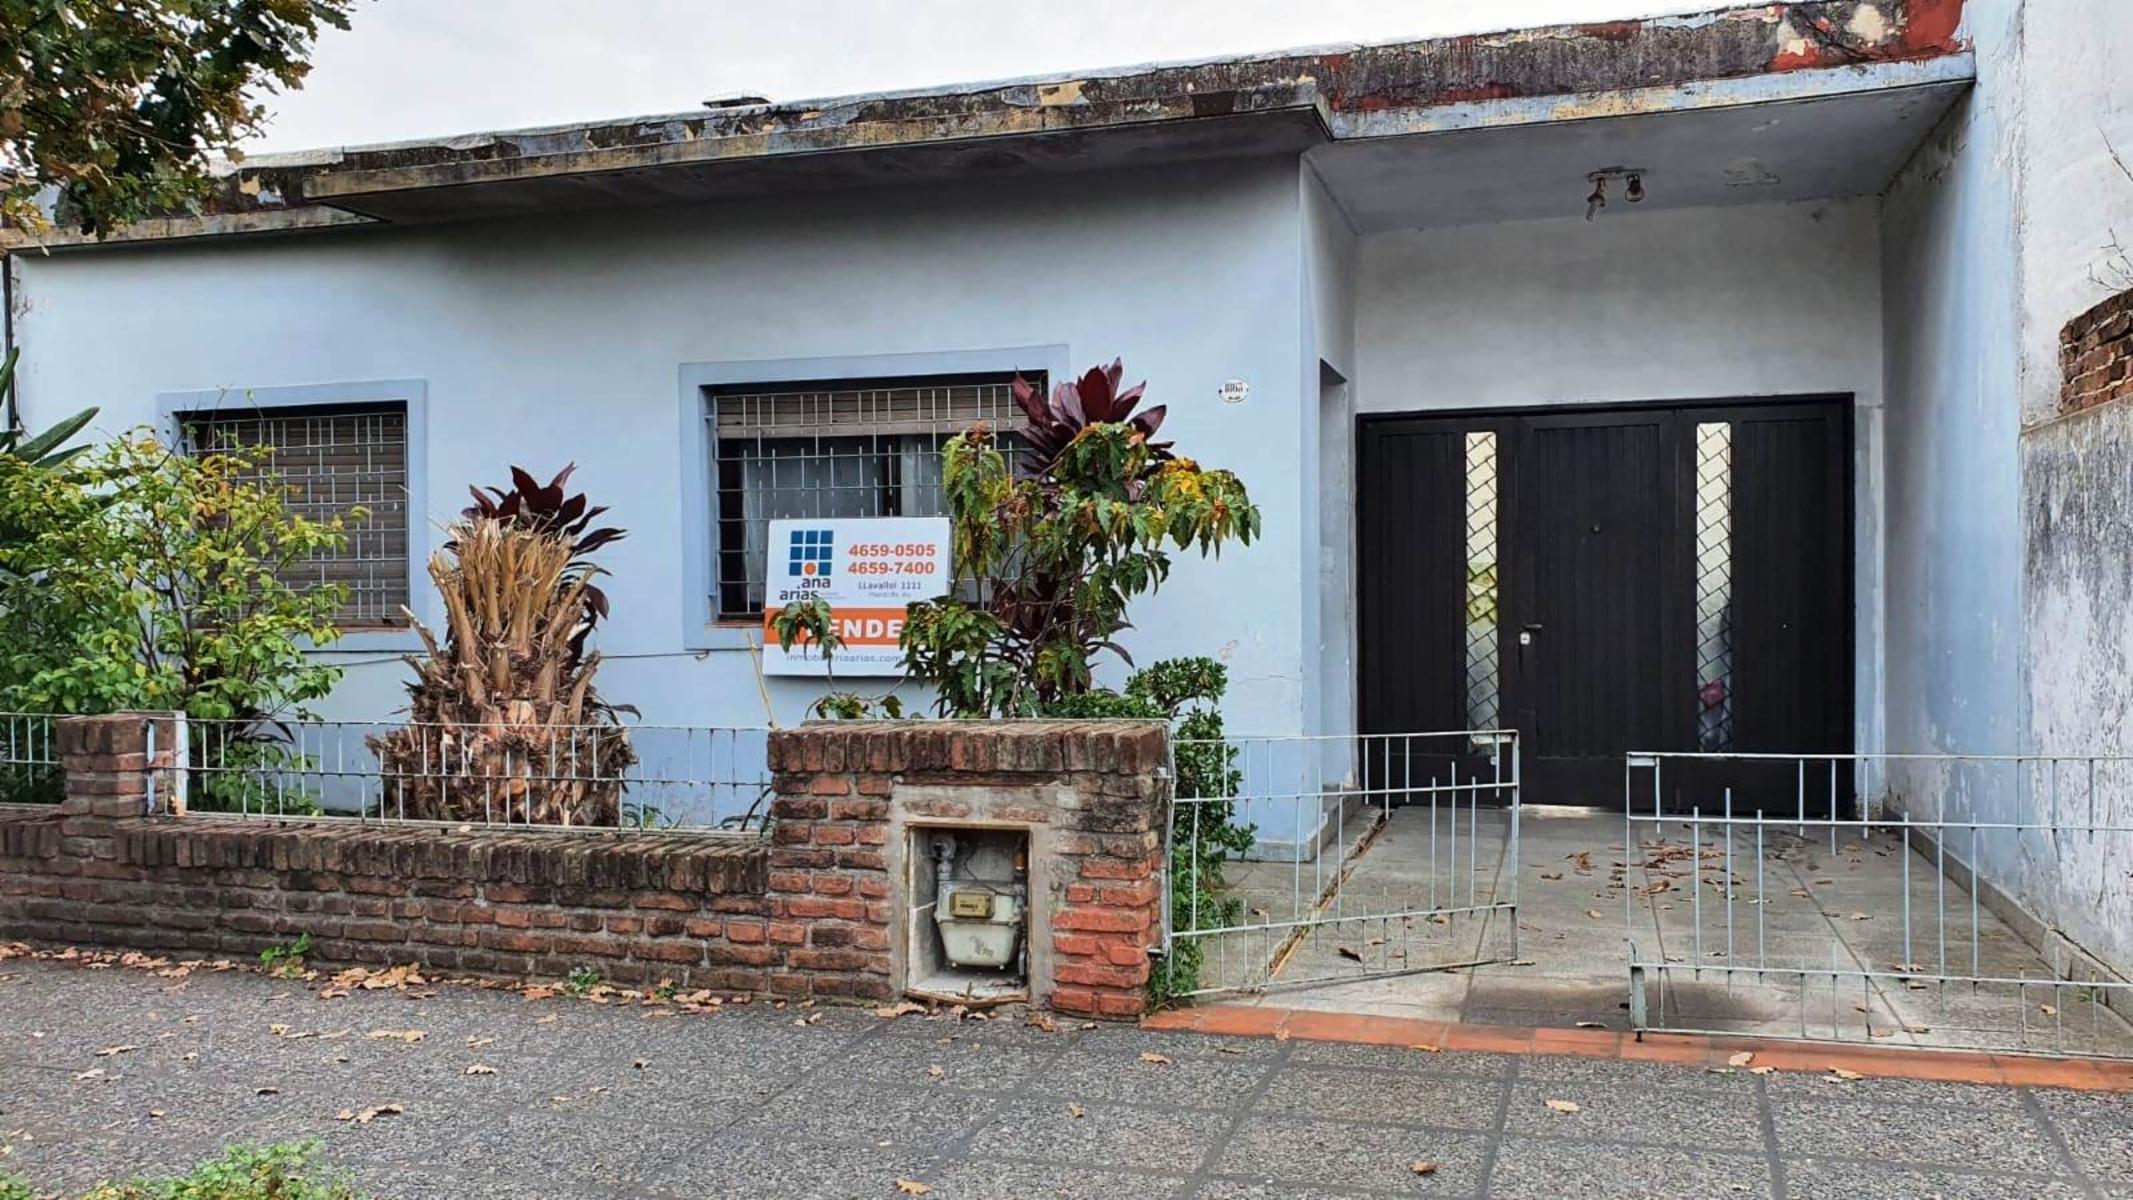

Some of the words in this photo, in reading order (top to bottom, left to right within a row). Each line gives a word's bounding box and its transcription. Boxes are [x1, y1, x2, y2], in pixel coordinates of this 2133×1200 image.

[848, 544, 936, 557] 4659-0505
[848, 561, 935, 574] 4659-7400
[801, 577, 832, 589] ana
[779, 585, 819, 601] arias
[804, 619, 904, 639] ENDE
